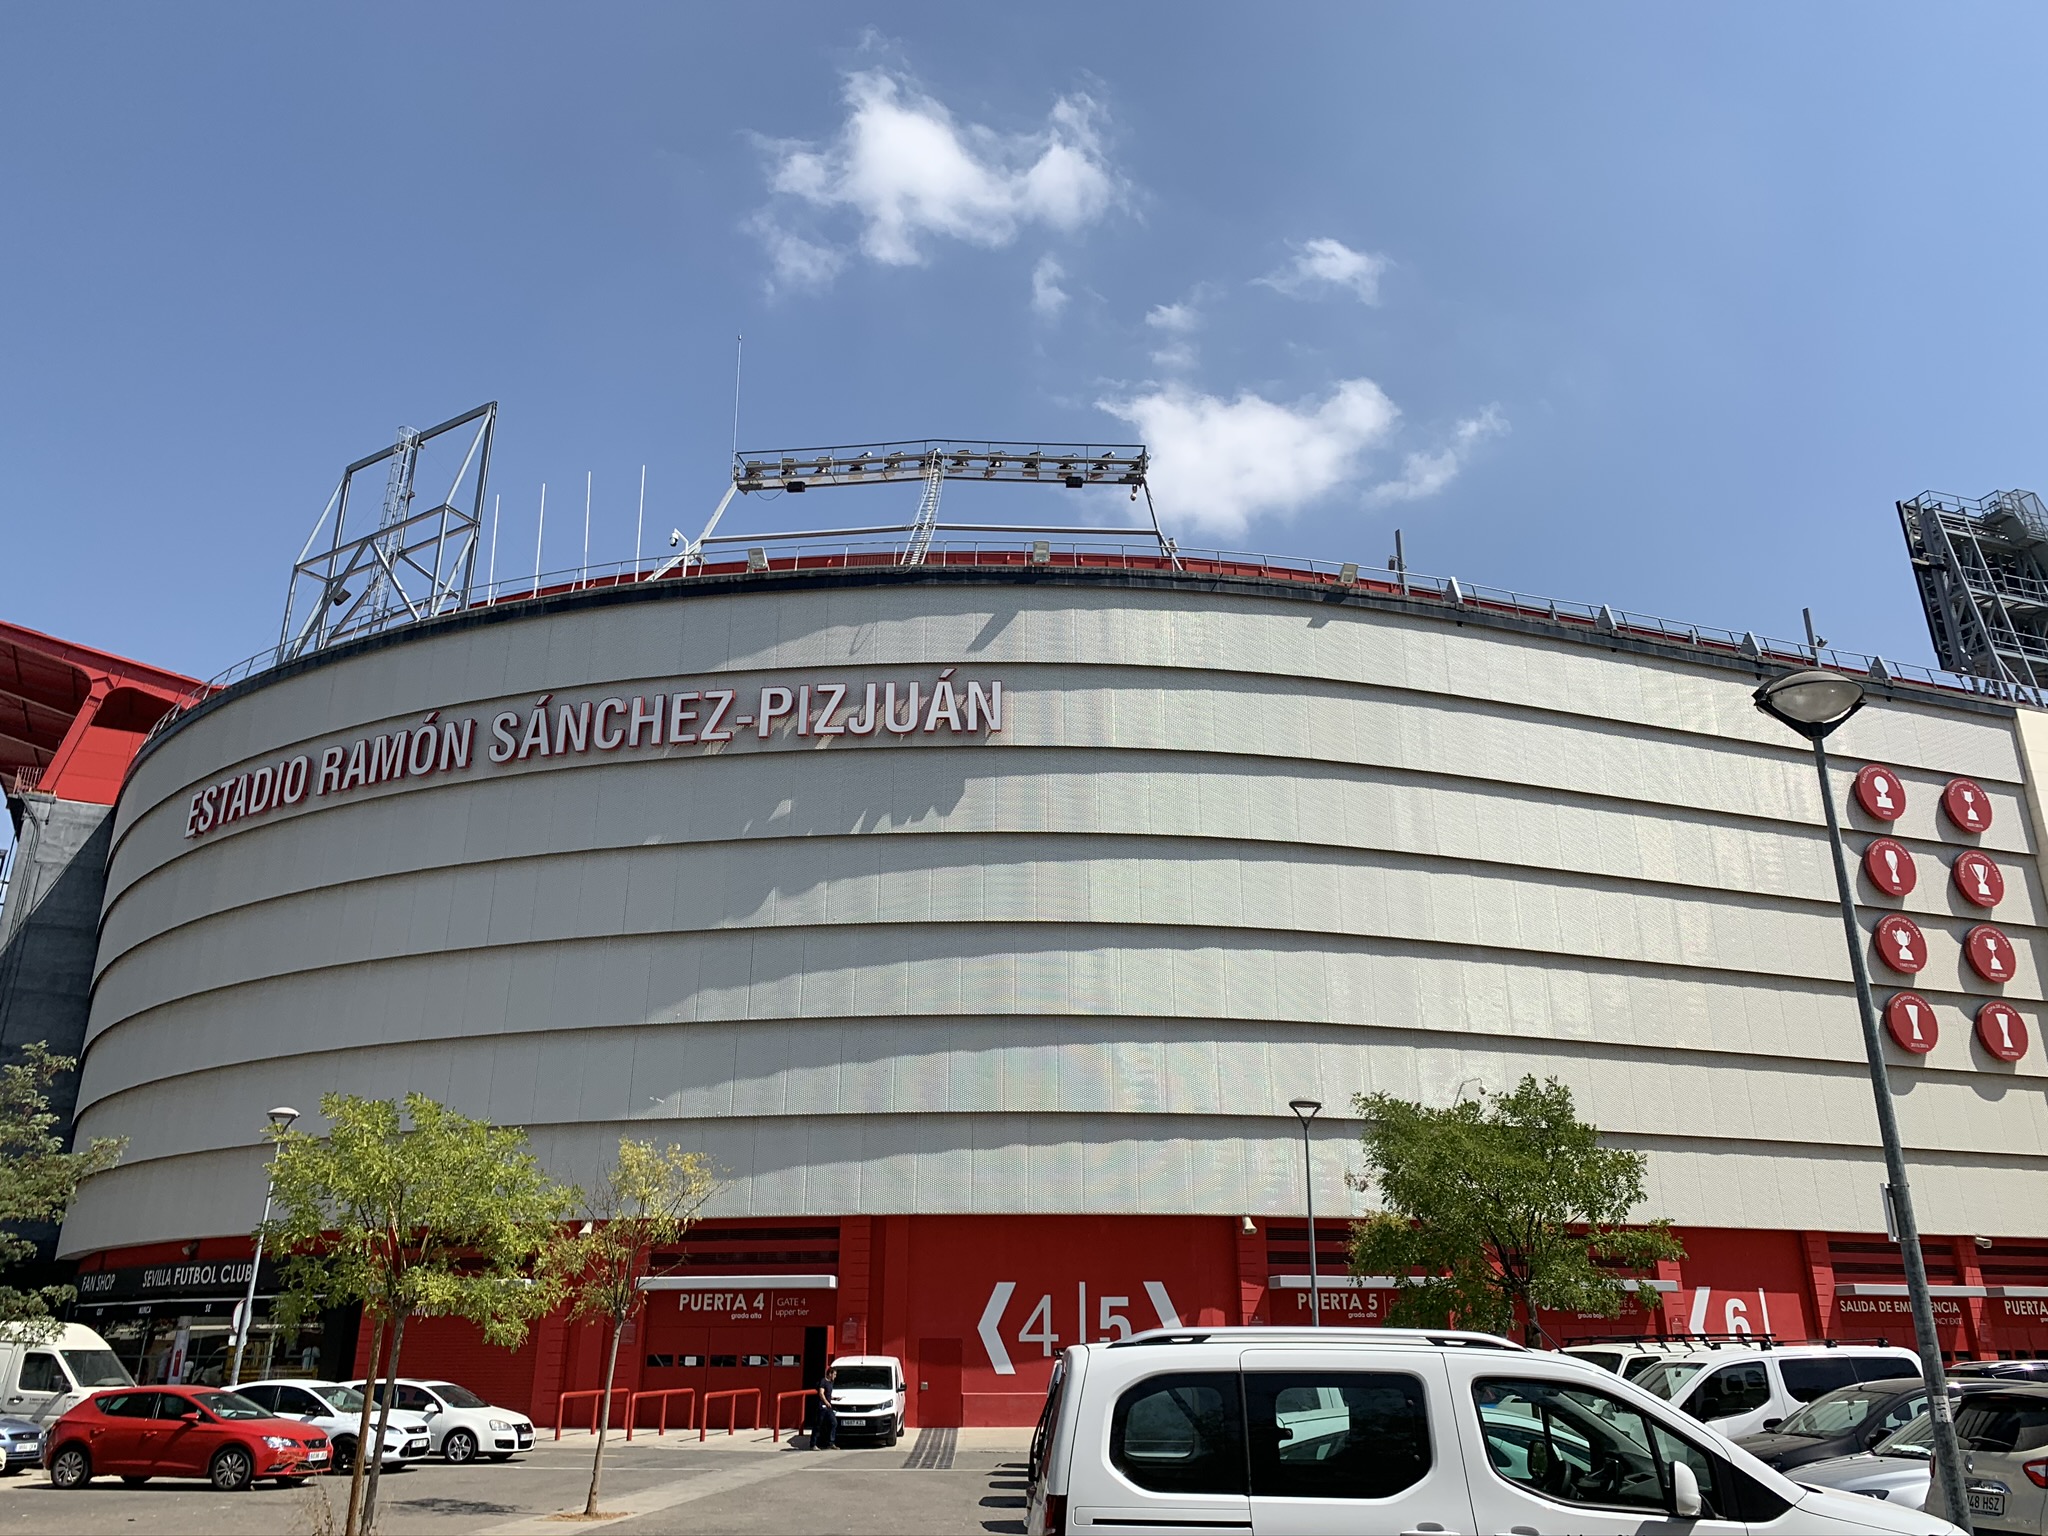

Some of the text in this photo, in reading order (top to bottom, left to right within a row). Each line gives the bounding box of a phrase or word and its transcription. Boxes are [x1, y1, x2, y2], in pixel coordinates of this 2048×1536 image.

[183, 668, 1003, 839] ESTADIO RAMÓN SÁNCHEZ-PIZJUÁN
[81, 1274, 116, 1292] FAN SHOP
[142, 1264, 253, 1289] SEVILLA FUTBOL CLUB
[679, 1292, 765, 1311] PUERTA 4
[777, 1297, 807, 1307] GATE 4
[1367, 1293, 1378, 1311] 5
[1840, 1300, 1961, 1314] SALIDA DE EMENCIA
[2004, 1300, 2048, 1315] PUERTA
[731, 1311, 762, 1320] grada alta
[775, 1307, 809, 1317] upper tier
[1725, 1298, 1753, 1340] 6
[1018, 1294, 1133, 1357] 4 5
[1982, 1496, 2000, 1511] HSZ
